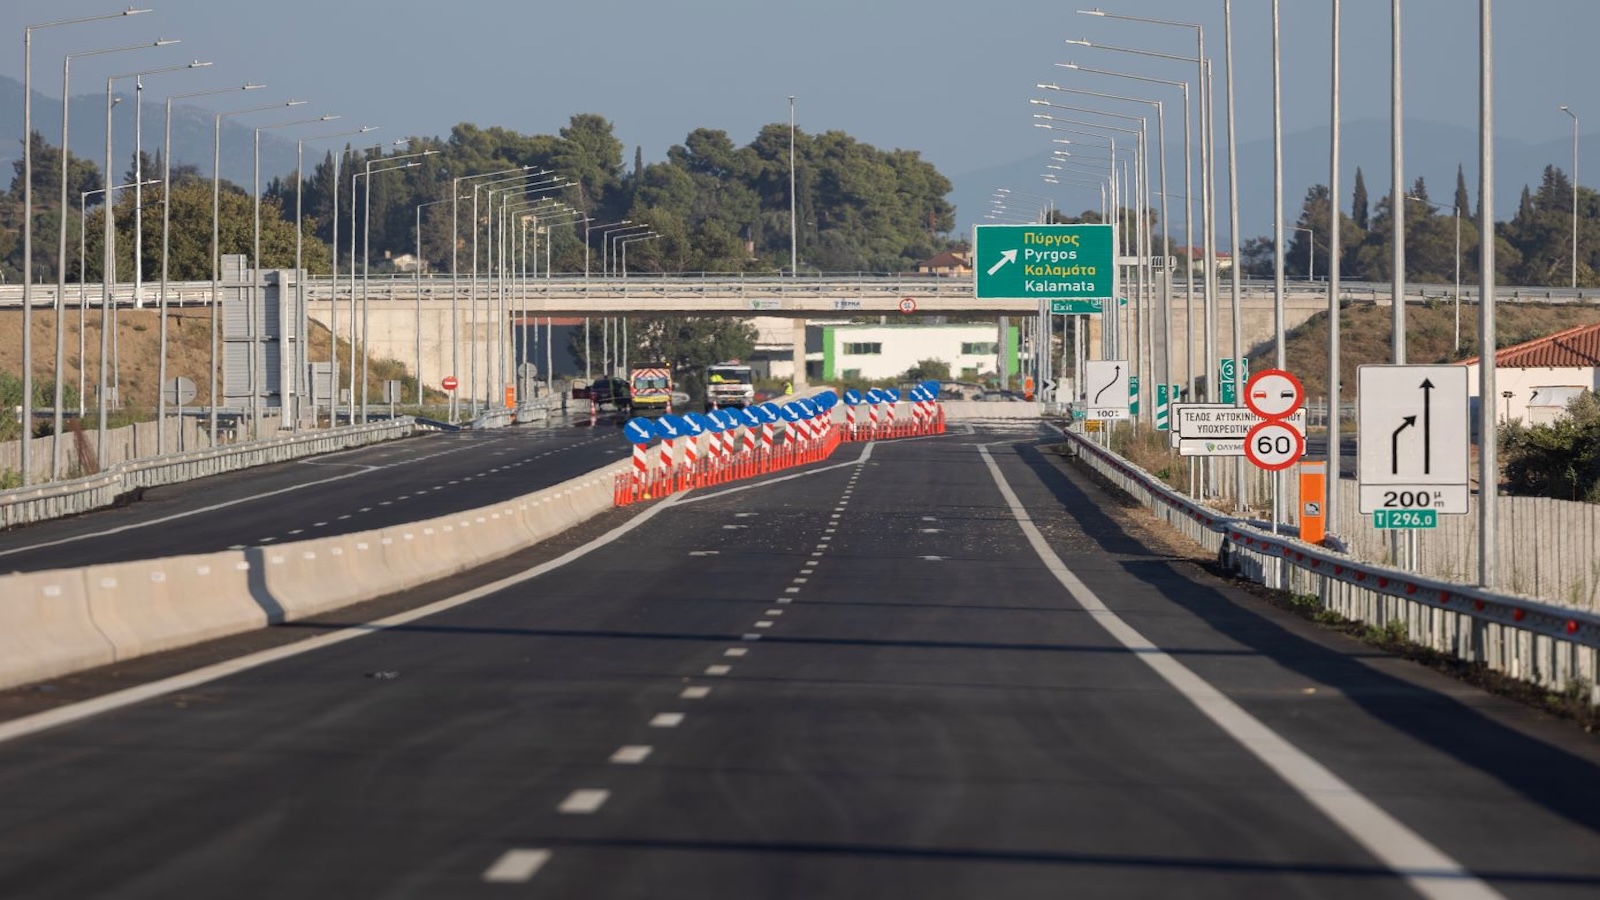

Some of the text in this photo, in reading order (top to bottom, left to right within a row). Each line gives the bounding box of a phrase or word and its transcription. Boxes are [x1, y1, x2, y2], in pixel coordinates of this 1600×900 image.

[1024, 232, 1080, 247] Πύργος
[1024, 248, 1077, 263] Pyrgos
[1024, 264, 1096, 278] Καλαμάτα
[1025, 280, 1095, 292] Kalamata
[1053, 303, 1073, 311] Exit
[1185, 412, 1211, 421] ΤΕΛΟΣ
[1257, 436, 1290, 454] 60
[1383, 491, 1430, 507] 200
[1376, 512, 1433, 525] T 296.0
